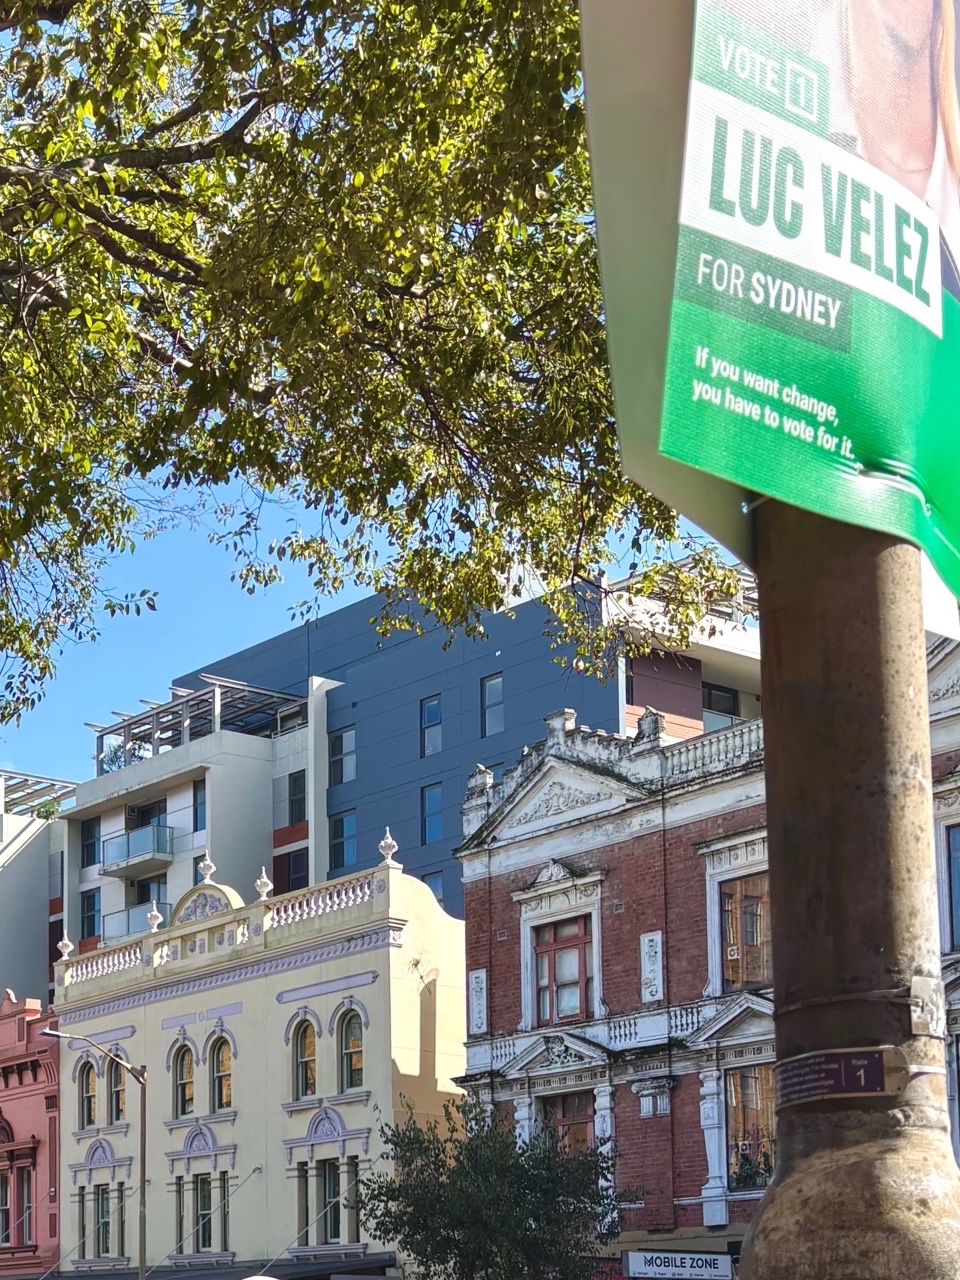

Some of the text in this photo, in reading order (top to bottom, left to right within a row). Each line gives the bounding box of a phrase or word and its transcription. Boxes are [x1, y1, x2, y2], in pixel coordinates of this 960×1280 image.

[718, 35, 780, 96] VOTE
[709, 115, 931, 308] LUC VELEZ
[697, 252, 841, 328] FOR SYDNEY
[692, 379, 855, 460] you have to vote for it.
[695, 345, 839, 427] If you want change,
[856, 1068, 866, 1087] 1
[643, 1255, 719, 1270] MOBILE ZONE
